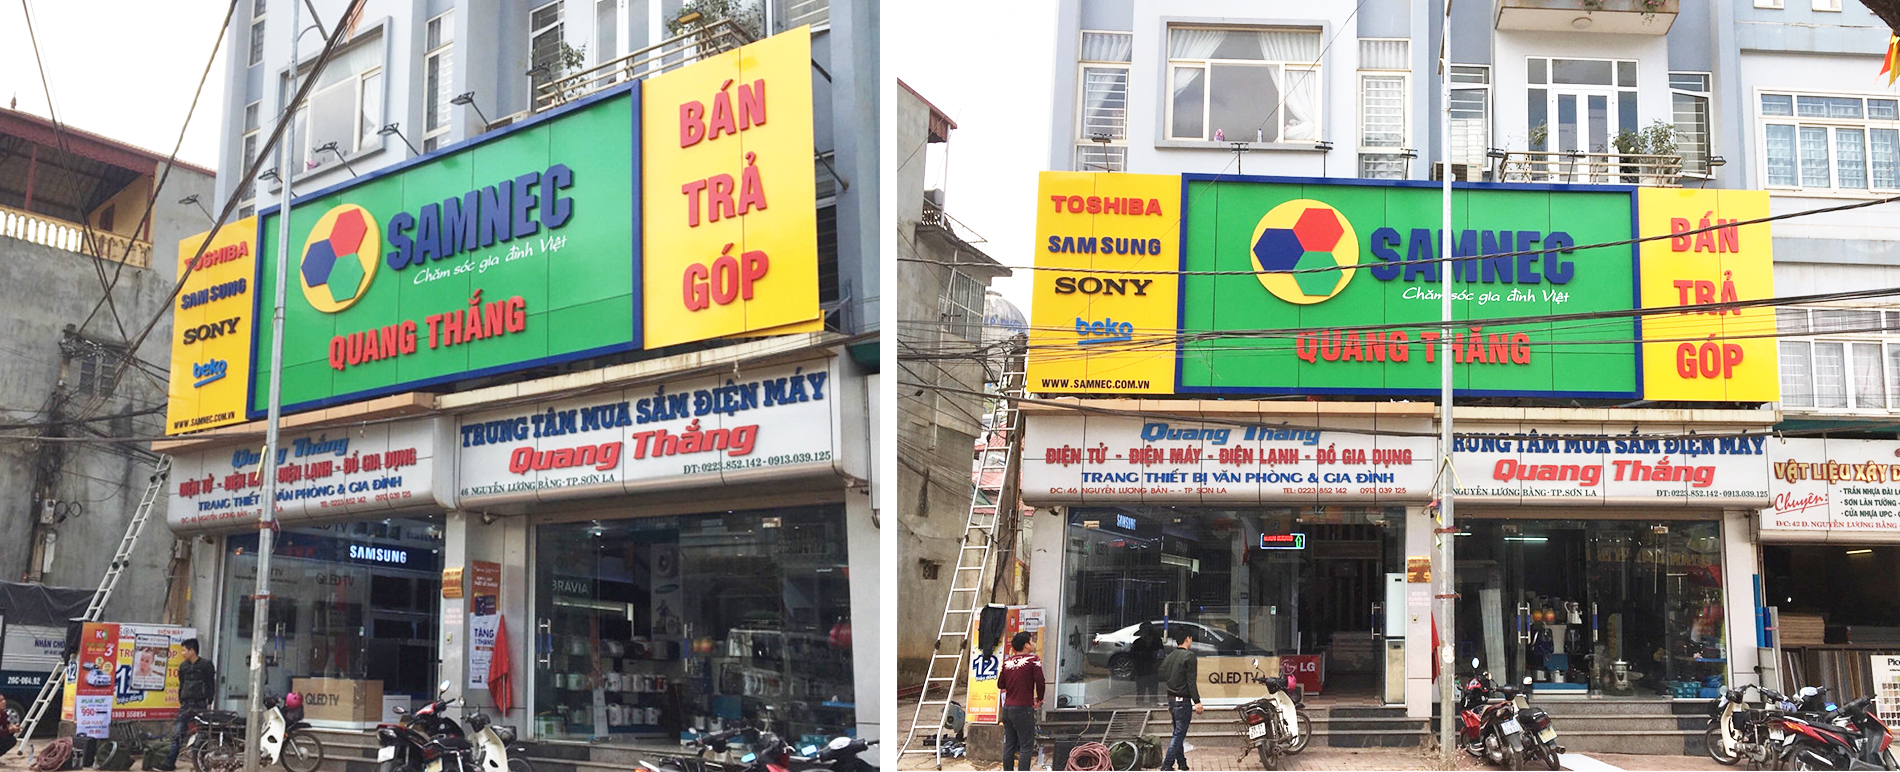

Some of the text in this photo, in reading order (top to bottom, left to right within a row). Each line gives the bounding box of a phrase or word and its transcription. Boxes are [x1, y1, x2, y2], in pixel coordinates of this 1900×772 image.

[680, 78, 766, 149] BÁN
[681, 150, 767, 227] TRẢ
[387, 163, 575, 270] SAMNEC
[1051, 195, 1162, 216] TOSHIBA
[1671, 211, 1739, 253] BÁN
[413, 235, 567, 285] Chăm sóc gia đình Việt
[1371, 227, 1574, 284] SAMNEC
[682, 242, 769, 312] GÓP
[1055, 277, 1152, 295] SONY
[1479, 291, 1500, 305] gia
[1507, 288, 1535, 302] đình
[1542, 289, 1570, 304] Việt
[1673, 270, 1741, 315] TRẢ
[183, 317, 240, 345] SONY
[328, 288, 526, 372] QUANG THẮNG
[1075, 318, 1133, 336] beko
[1296, 329, 1409, 363] QUANG
[1677, 334, 1744, 379] GÓP
[193, 359, 227, 379] beko
[461, 367, 828, 448] TRUNG TÂM MUA SẮM ĐIỆN MÁY
[1141, 422, 1230, 445] Quang
[1452, 433, 1511, 453] RUNG
[1719, 429, 1766, 455] MÁY
[509, 419, 759, 476] Quang Thắng
[1045, 445, 1081, 467] ĐIỆN
[1087, 442, 1108, 464] TỬ
[1129, 445, 1164, 467] ĐIỆN
[1170, 445, 1201, 464] MÁY
[1219, 445, 1253, 467] ĐIỆN
[1260, 448, 1299, 467] LẠNH
[1317, 442, 1336, 465] ĐỒ
[1342, 448, 1366, 465] GIA
[1372, 448, 1412, 468] DỤNG
[1082, 468, 1394, 485] TRANG THIẾT BỊ VĂN PHÒNG & GIA ĐÌNH
[1493, 456, 1716, 487] Quang Thắng
[1774, 458, 1809, 484] VẬT
[1811, 459, 1851, 485] LIỆU
[1853, 460, 1888, 483] XÂY
[1585, 488, 1597, 496] LA
[350, 545, 407, 564] SAMSUNG
[1208, 672, 1259, 684] QLED TV
[1300, 661, 1316, 672] LG
[305, 692, 327, 706] QLED
